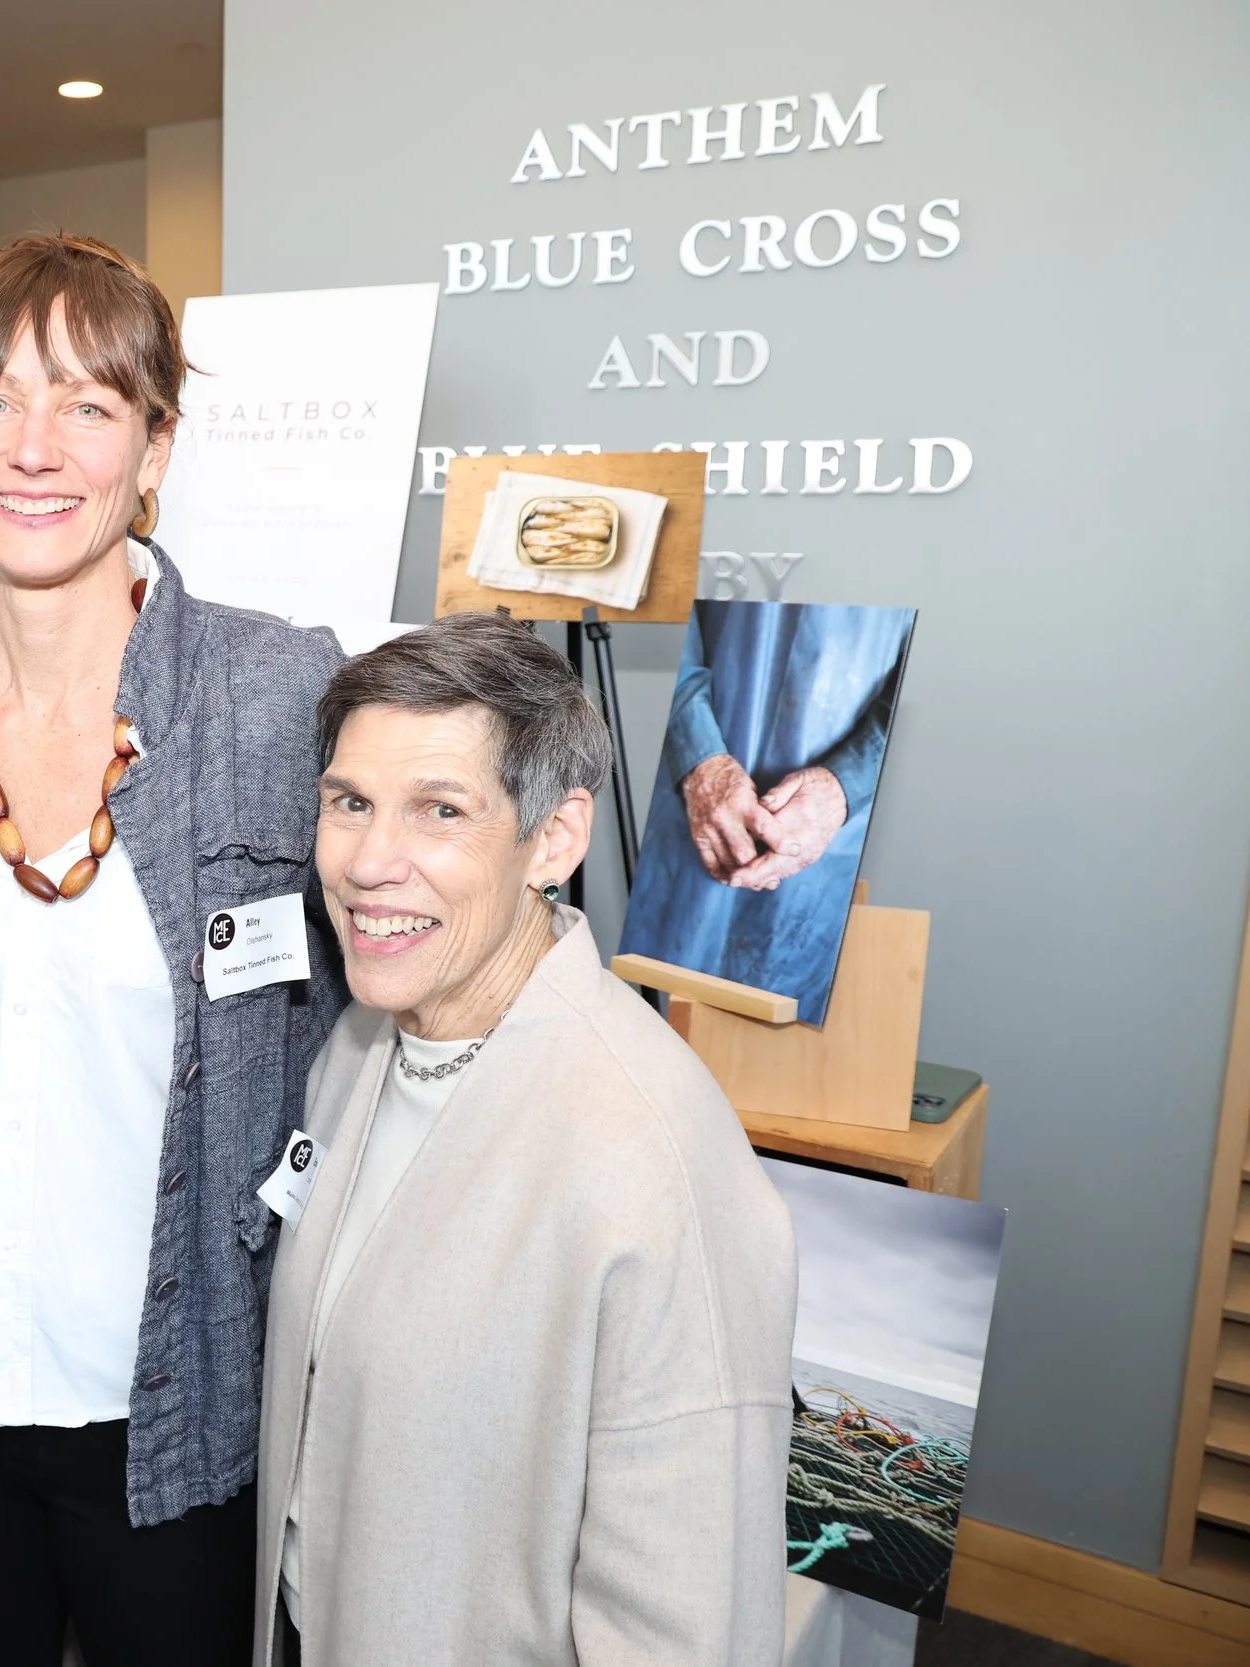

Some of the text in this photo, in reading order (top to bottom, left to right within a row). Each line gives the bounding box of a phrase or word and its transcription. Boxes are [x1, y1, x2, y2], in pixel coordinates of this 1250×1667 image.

[510, 83, 887, 184] ANTHEM
[443, 198, 962, 296] BLUE CROSS
[587, 330, 772, 390] AND
[205, 425, 373, 442] Tinned Fish Co.
[206, 400, 379, 423] SALTBOX
[652, 437, 973, 496] HIELD
[698, 551, 805, 601] BY
[245, 918, 260, 928] Alley
[222, 951, 294, 976] Saltbox Tinned Fish Co.
